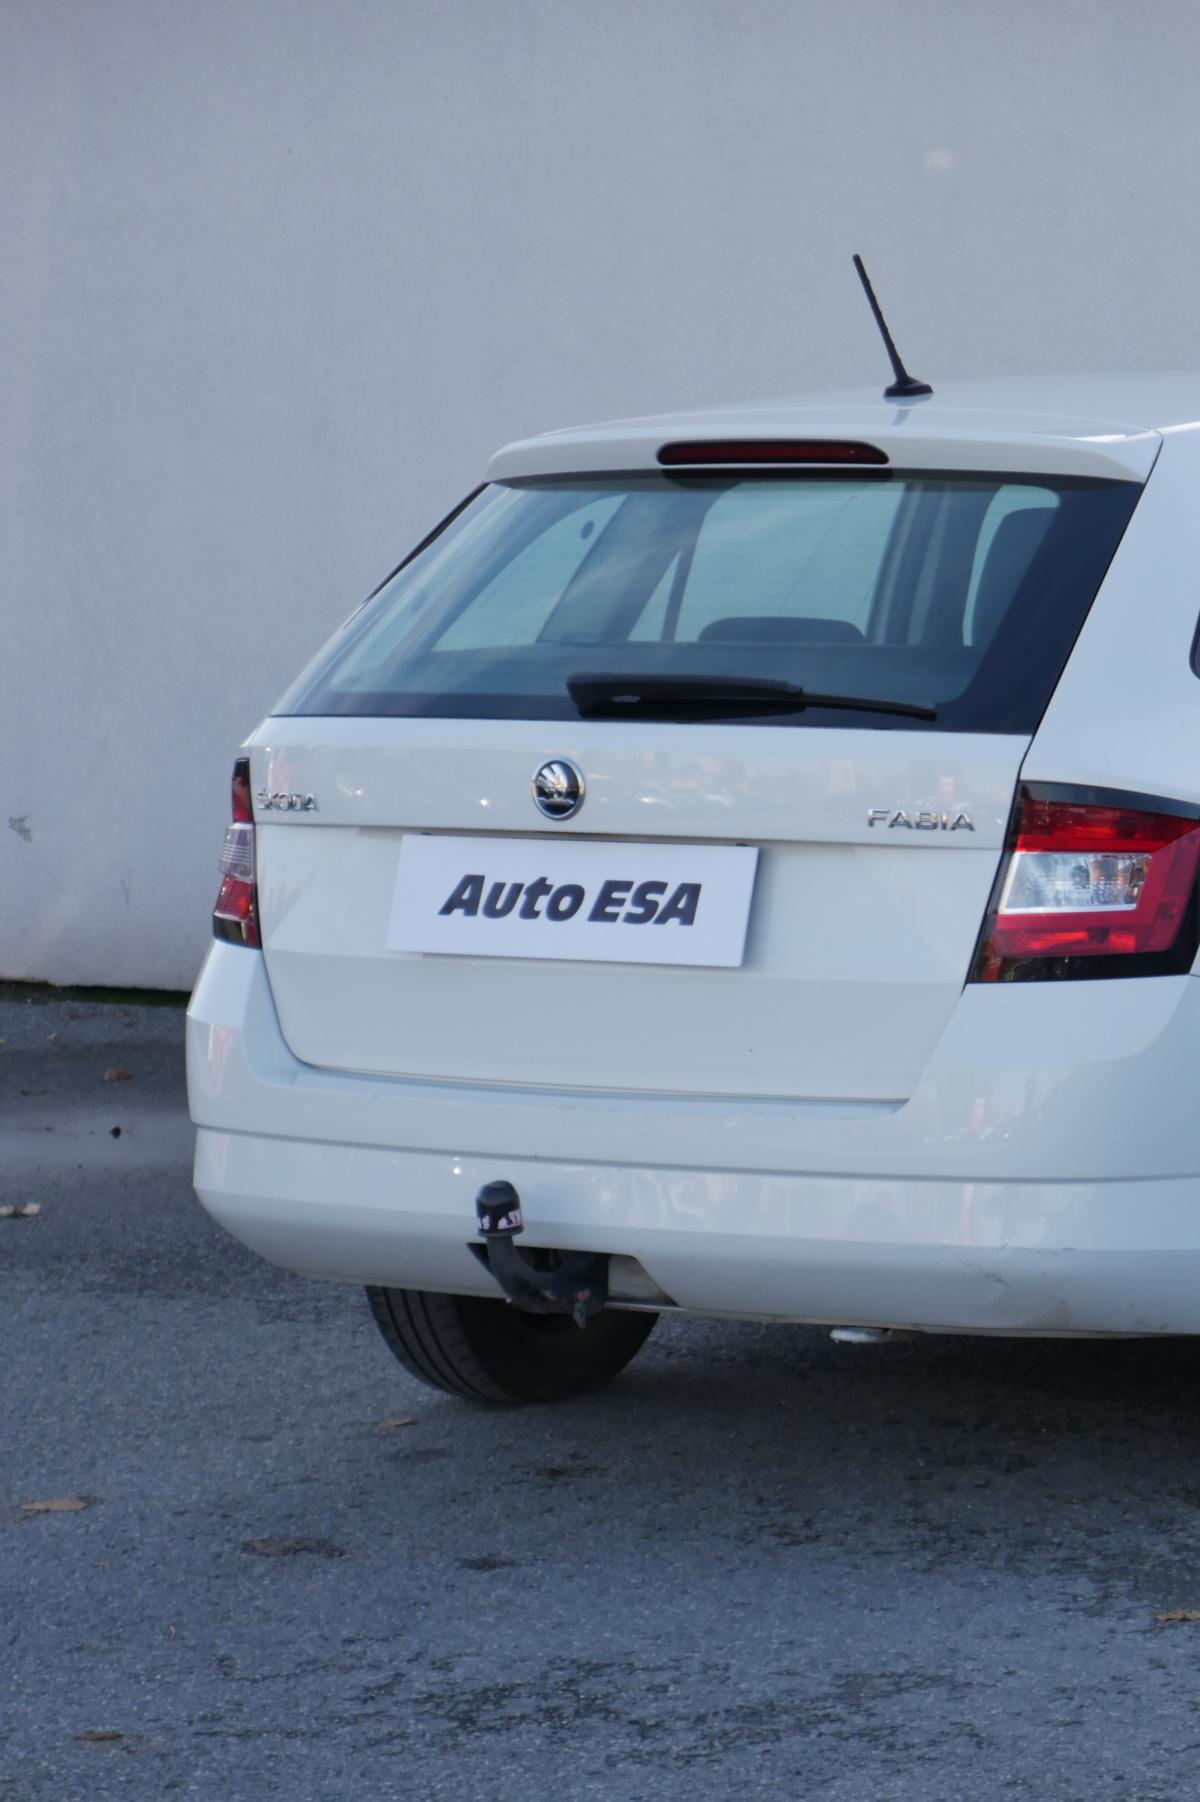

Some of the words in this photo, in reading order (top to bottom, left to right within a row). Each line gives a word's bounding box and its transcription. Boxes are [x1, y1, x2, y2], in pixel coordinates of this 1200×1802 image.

[867, 808, 976, 832] FABIA
[438, 874, 585, 922] Auto
[587, 879, 702, 926] ESA
